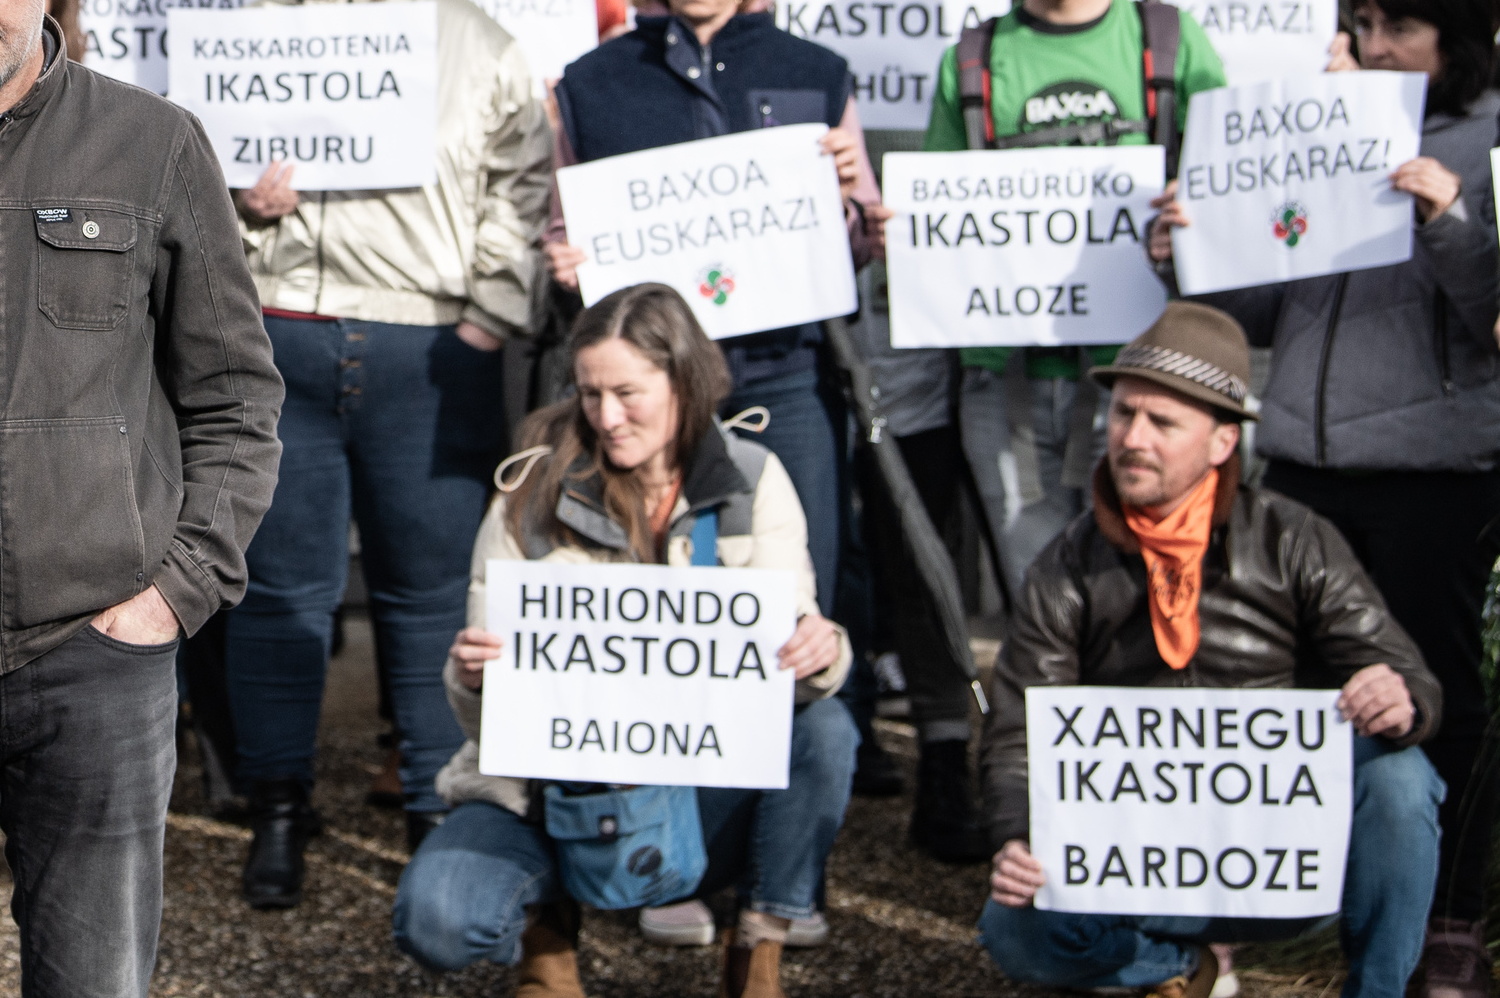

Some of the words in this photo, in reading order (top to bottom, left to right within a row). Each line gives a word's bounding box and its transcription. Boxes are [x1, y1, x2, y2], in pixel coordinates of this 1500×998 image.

[194, 33, 412, 60] KASKAROTENIA
[206, 70, 402, 103] IKASTOLA
[1225, 97, 1350, 144] BAXOA
[232, 135, 374, 164] ZIBURU
[1187, 138, 1392, 200] EUSKARAZ!
[627, 159, 769, 212] BAXOA
[912, 170, 1134, 201] BASABÜRÜKO
[592, 197, 820, 267] EUSKARAZ!
[909, 207, 1141, 248] IKASTOLA
[966, 283, 1089, 317] ALOZE
[519, 584, 761, 628] HIRIONDO
[513, 631, 768, 681] IKASTOLA
[550, 717, 724, 759] BAIONA
[1051, 706, 1326, 751] XARNEGU
[1057, 760, 1324, 806] IKASTOLA
[1064, 844, 1320, 891] BARDOZE
